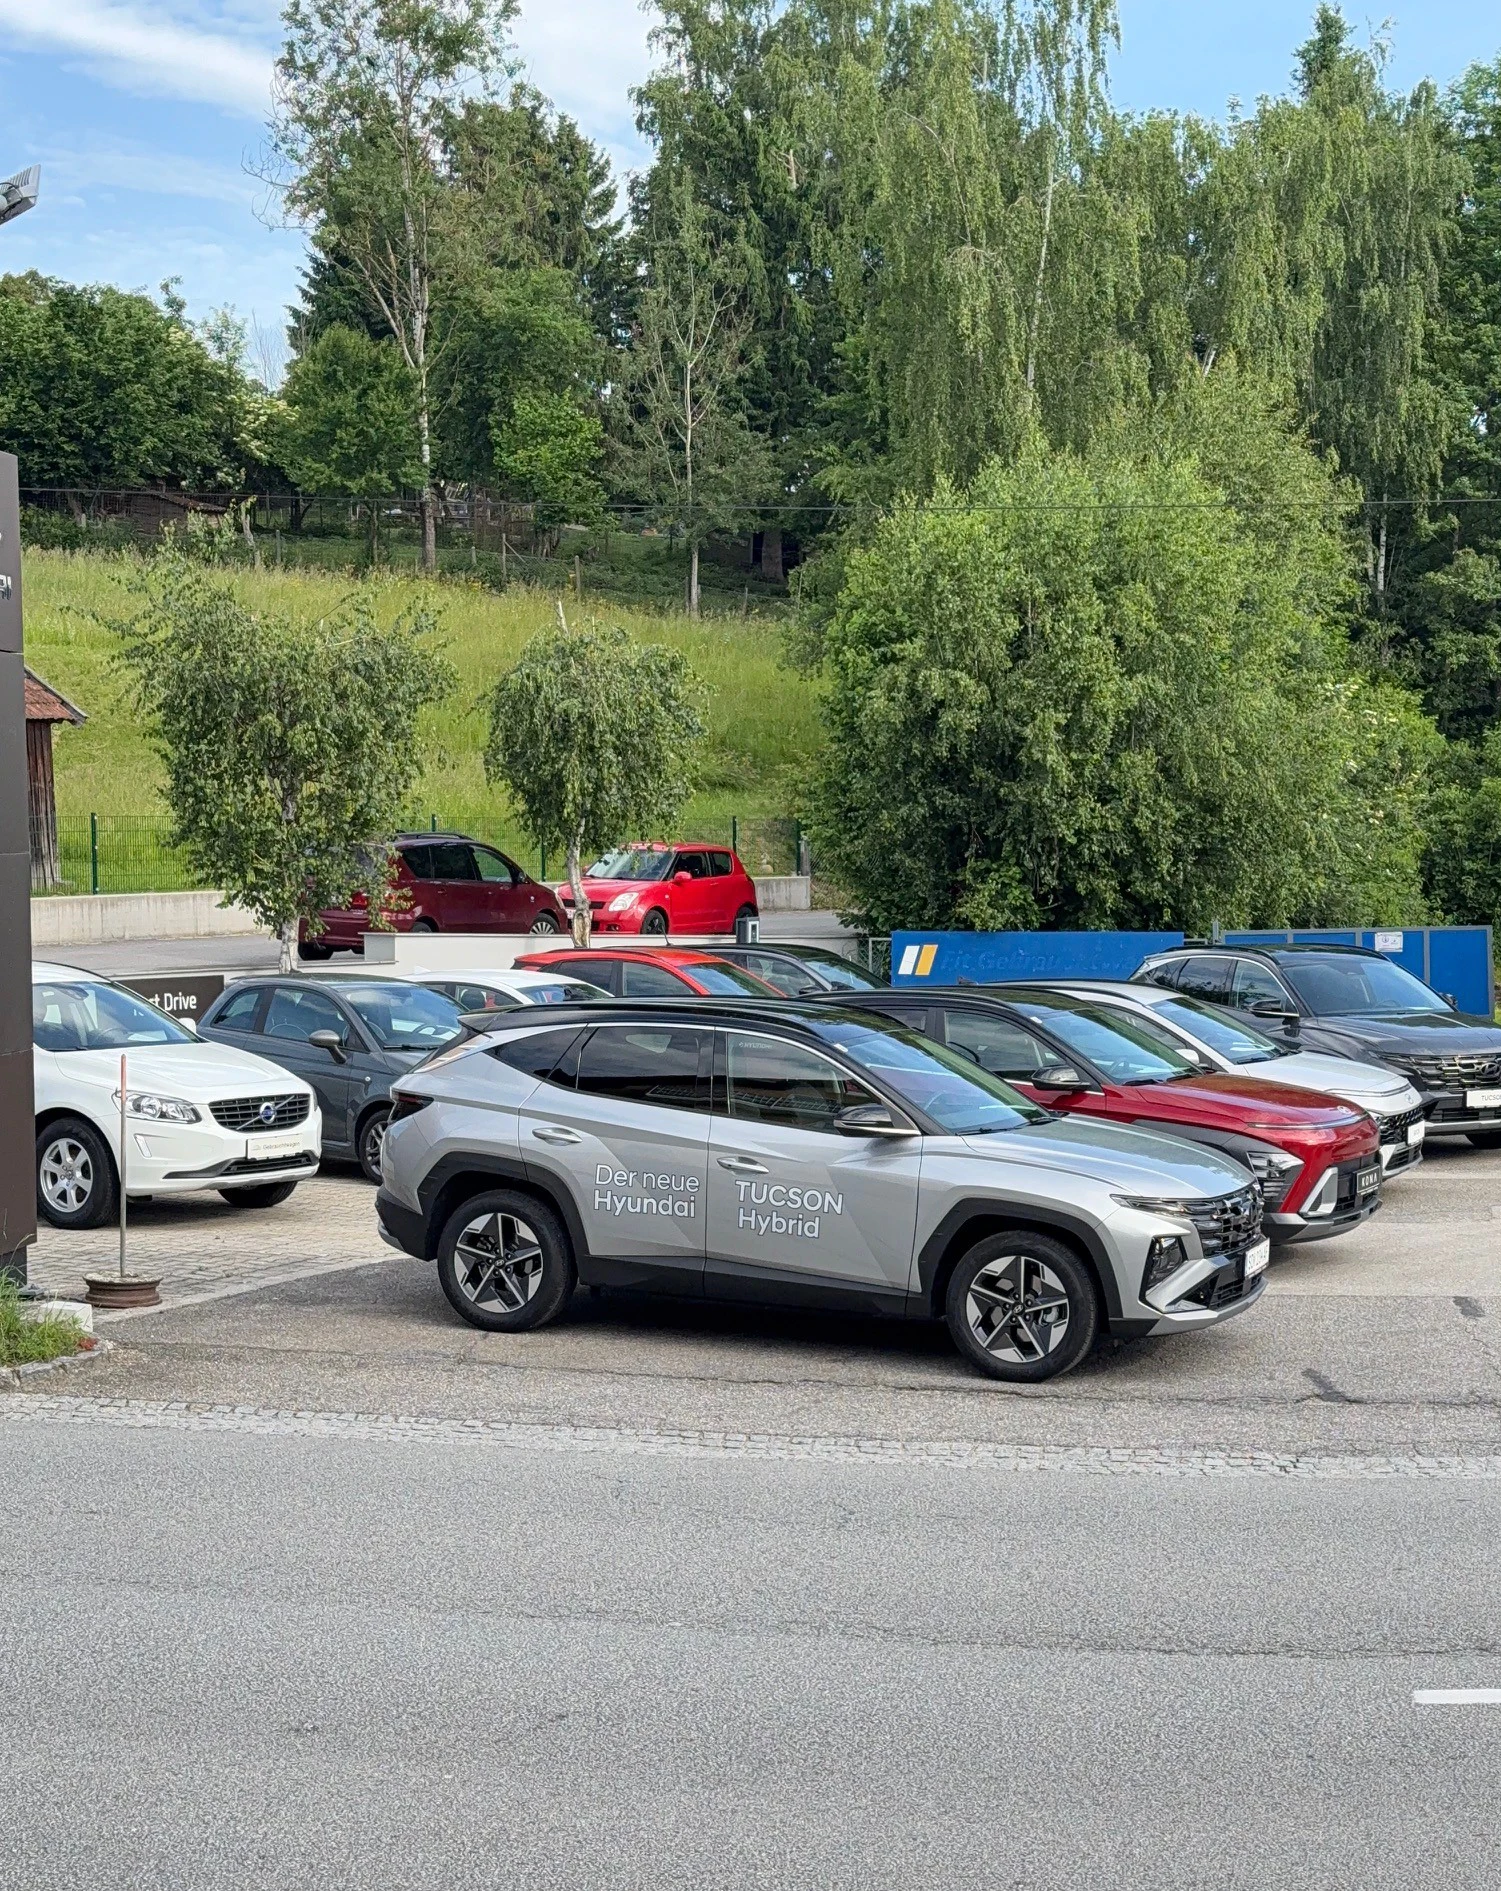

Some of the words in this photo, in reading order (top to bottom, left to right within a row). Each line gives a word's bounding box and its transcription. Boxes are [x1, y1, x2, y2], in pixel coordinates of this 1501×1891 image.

[164, 992, 197, 1011] Drive
[595, 1164, 638, 1188] Der
[642, 1171, 700, 1193] neue
[593, 1189, 696, 1218] Hyundai
[735, 1179, 844, 1216] TUCSON
[737, 1208, 821, 1240] Hybrid
